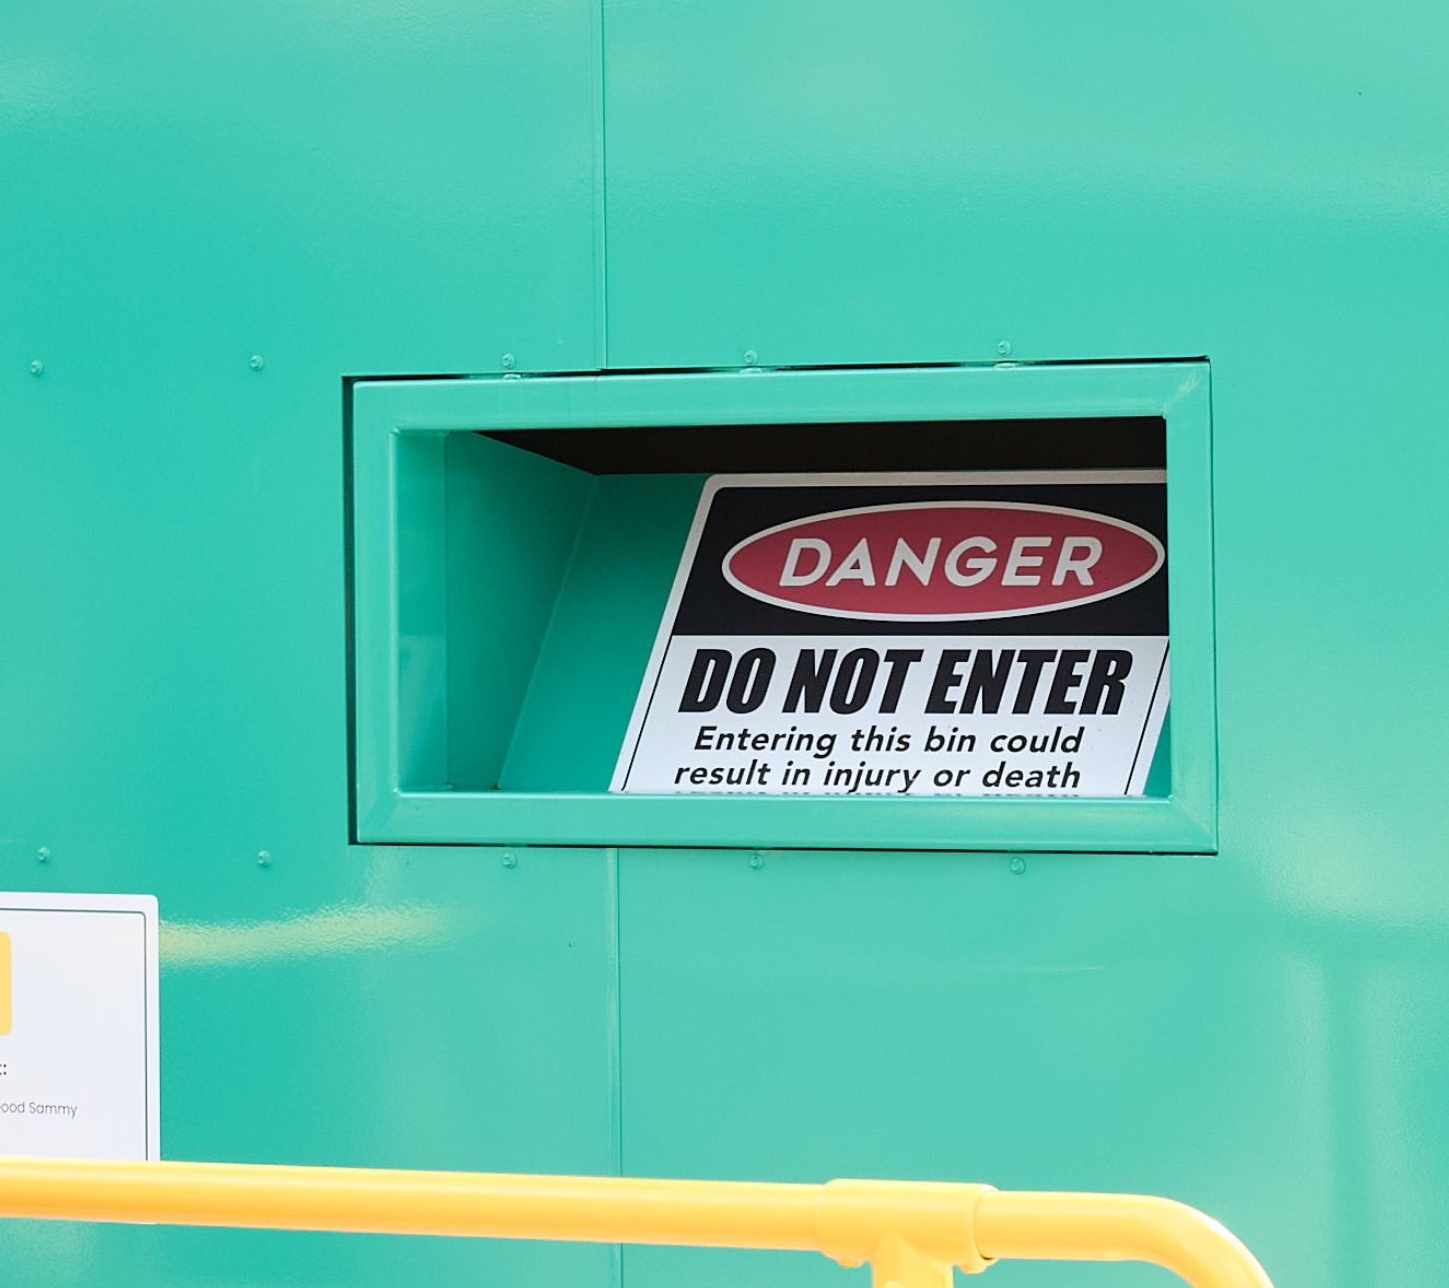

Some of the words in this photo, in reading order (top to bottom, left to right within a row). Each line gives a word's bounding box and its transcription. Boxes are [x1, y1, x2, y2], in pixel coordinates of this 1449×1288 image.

[779, 536, 1102, 587] DANGER
[678, 648, 776, 714] DO
[782, 648, 924, 714] NOT
[924, 649, 1133, 715] ENTER
[695, 726, 837, 760] Entering
[852, 725, 911, 751] this
[924, 726, 976, 752] bin
[991, 726, 1085, 753] could
[675, 759, 771, 785] result
[782, 761, 810, 785] in
[824, 761, 921, 792] injury
[934, 770, 970, 787] or
[982, 761, 1080, 788] death
[29, 1102, 77, 1119] Sammy
